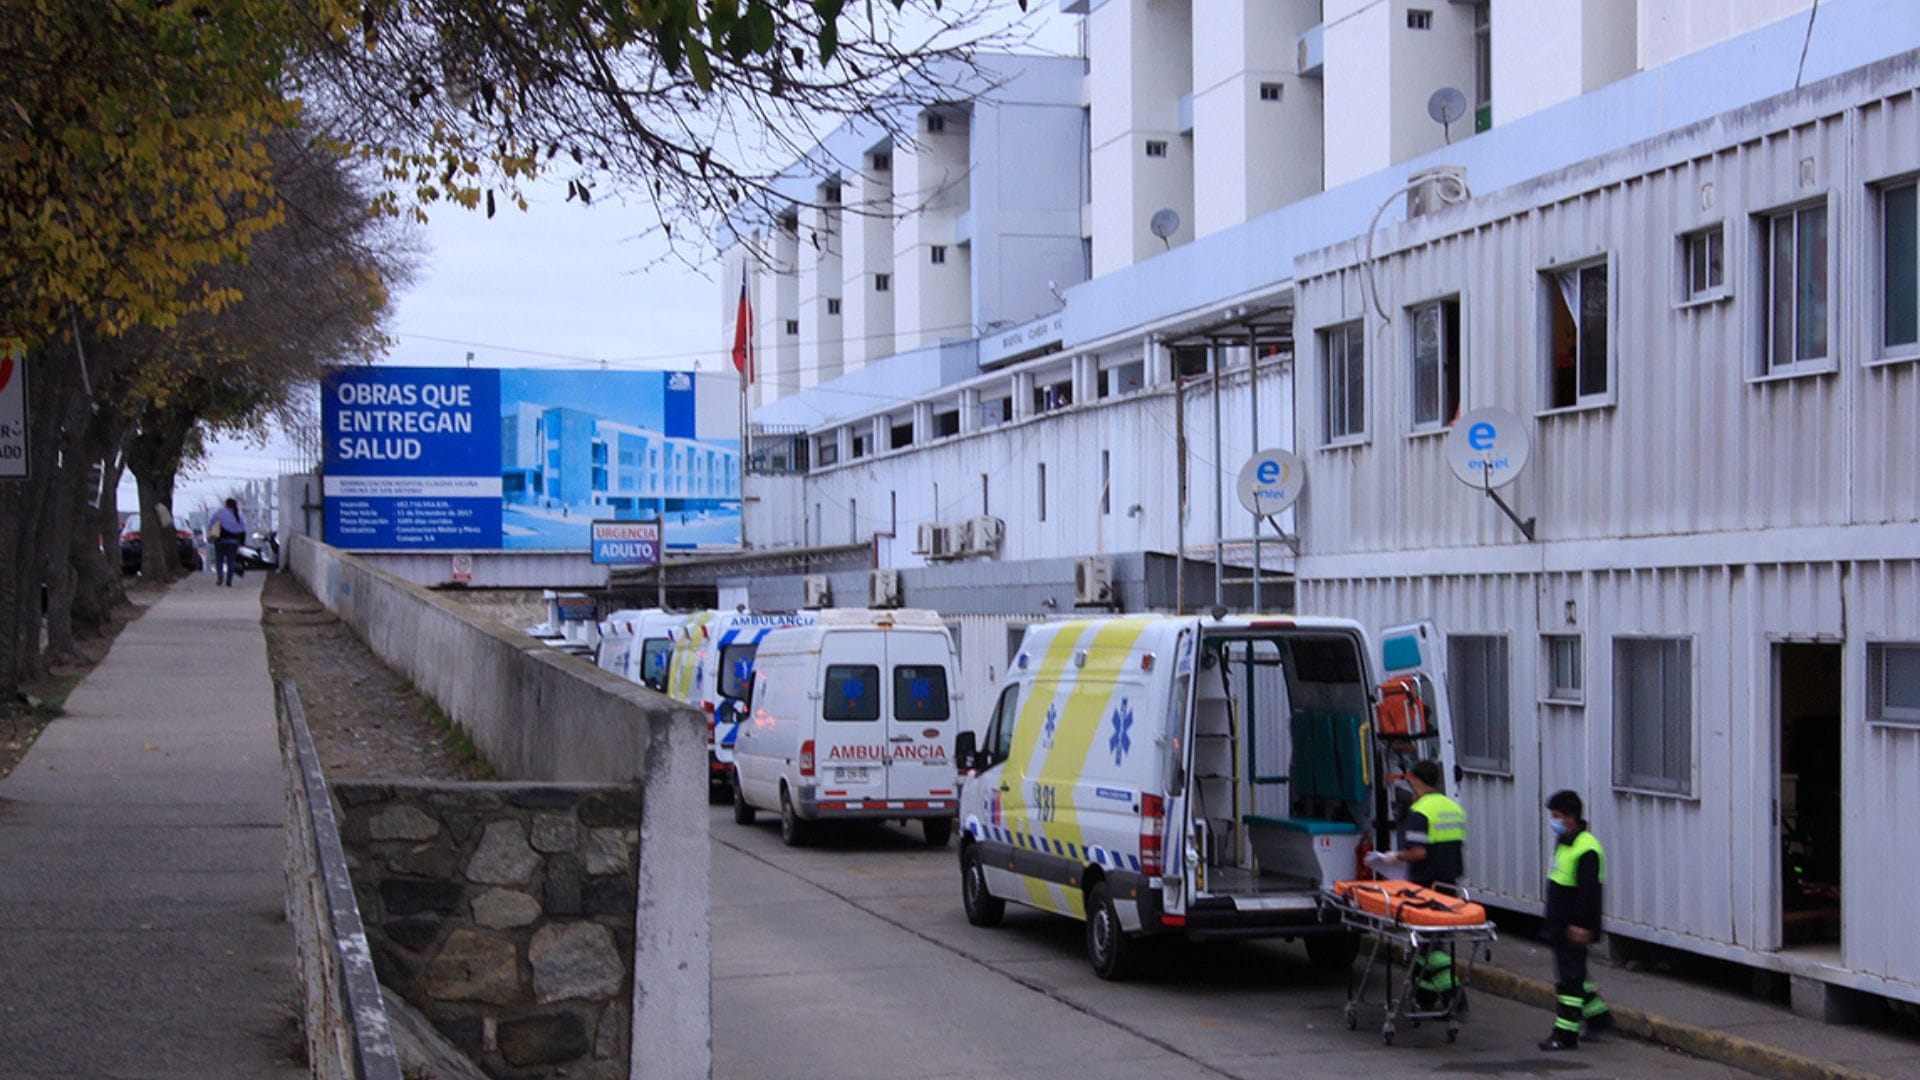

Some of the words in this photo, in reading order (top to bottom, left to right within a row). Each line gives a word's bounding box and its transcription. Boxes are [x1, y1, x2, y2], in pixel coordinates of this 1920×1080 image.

[339, 383, 418, 405] OBRAS
[421, 384, 472, 409] QUE
[339, 410, 472, 433] ENTREGAN
[339, 438, 422, 459] SALUD
[596, 527, 656, 539] URGENCIA
[600, 543, 653, 558] ADULTO
[829, 745, 946, 759] AMBULANCIA
